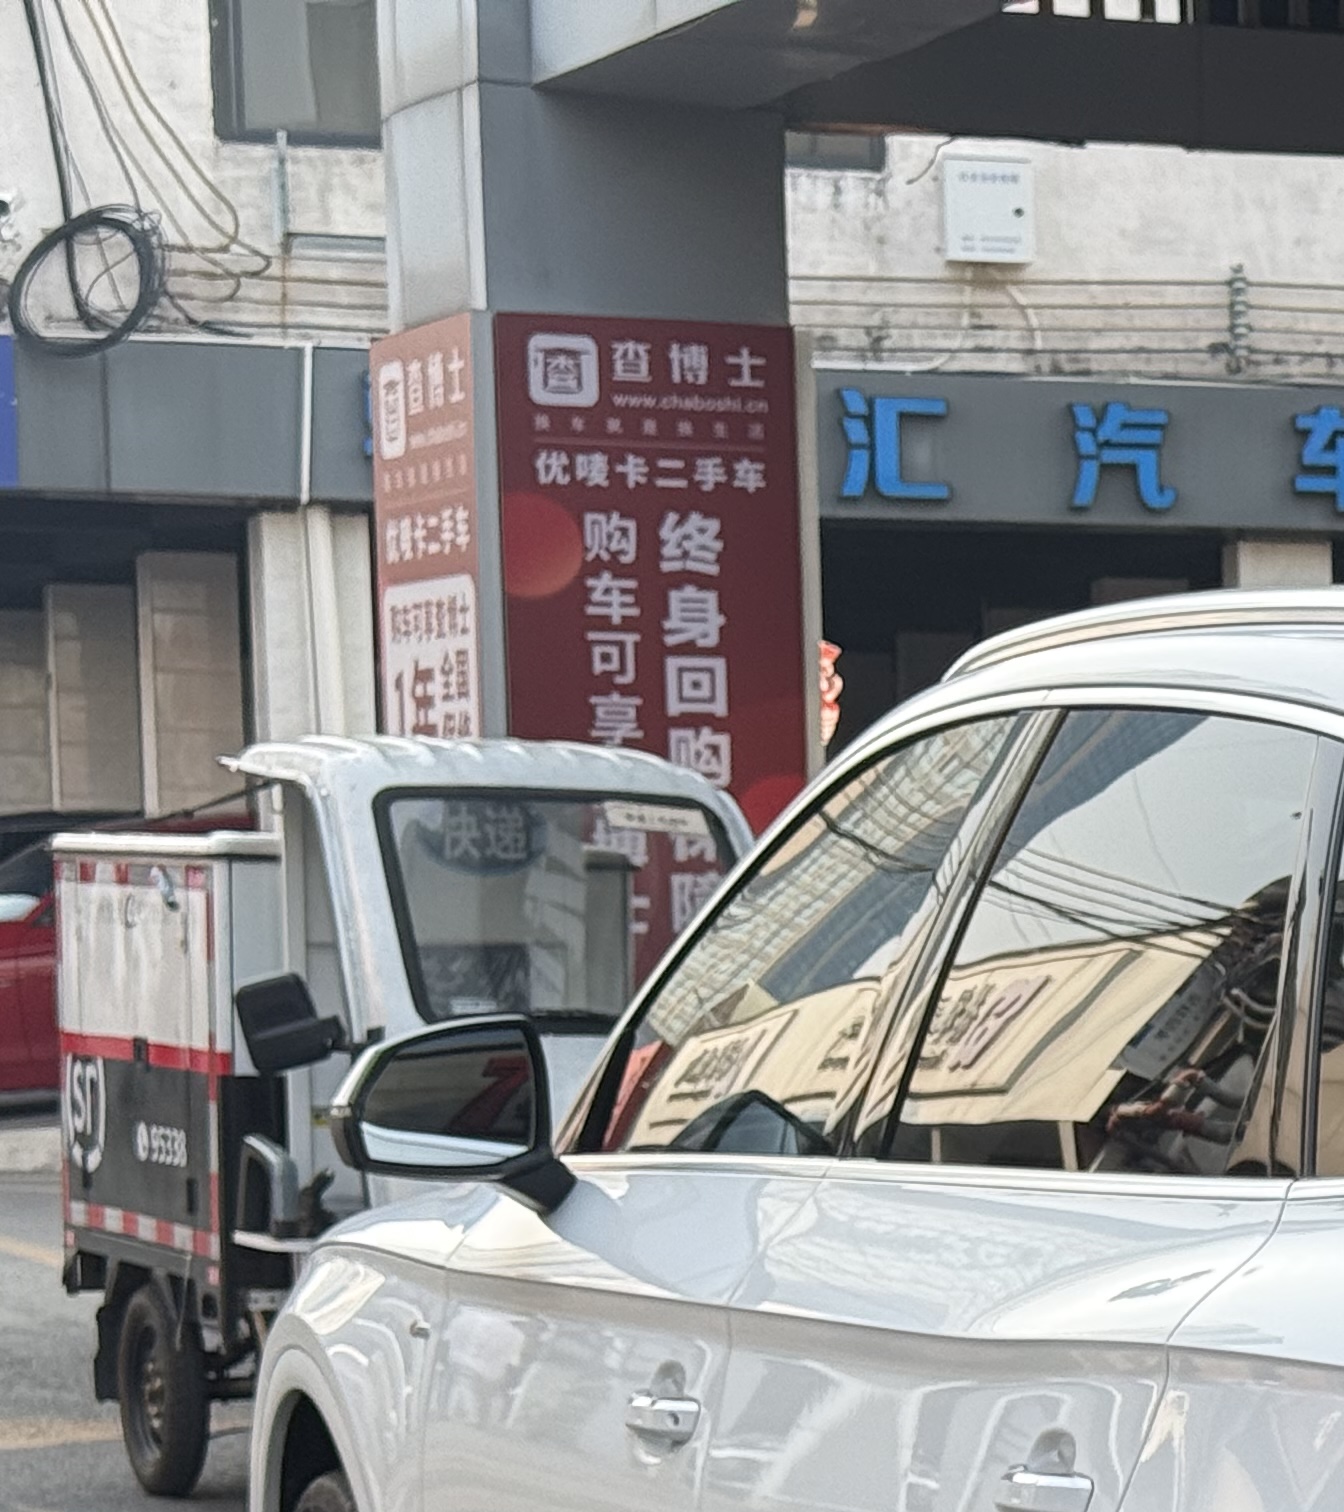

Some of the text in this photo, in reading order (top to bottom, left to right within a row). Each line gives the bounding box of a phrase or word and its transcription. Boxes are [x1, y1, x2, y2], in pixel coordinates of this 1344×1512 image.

[610, 340, 768, 388] 查博士
[611, 392, 769, 414] www.chaboshi.cn
